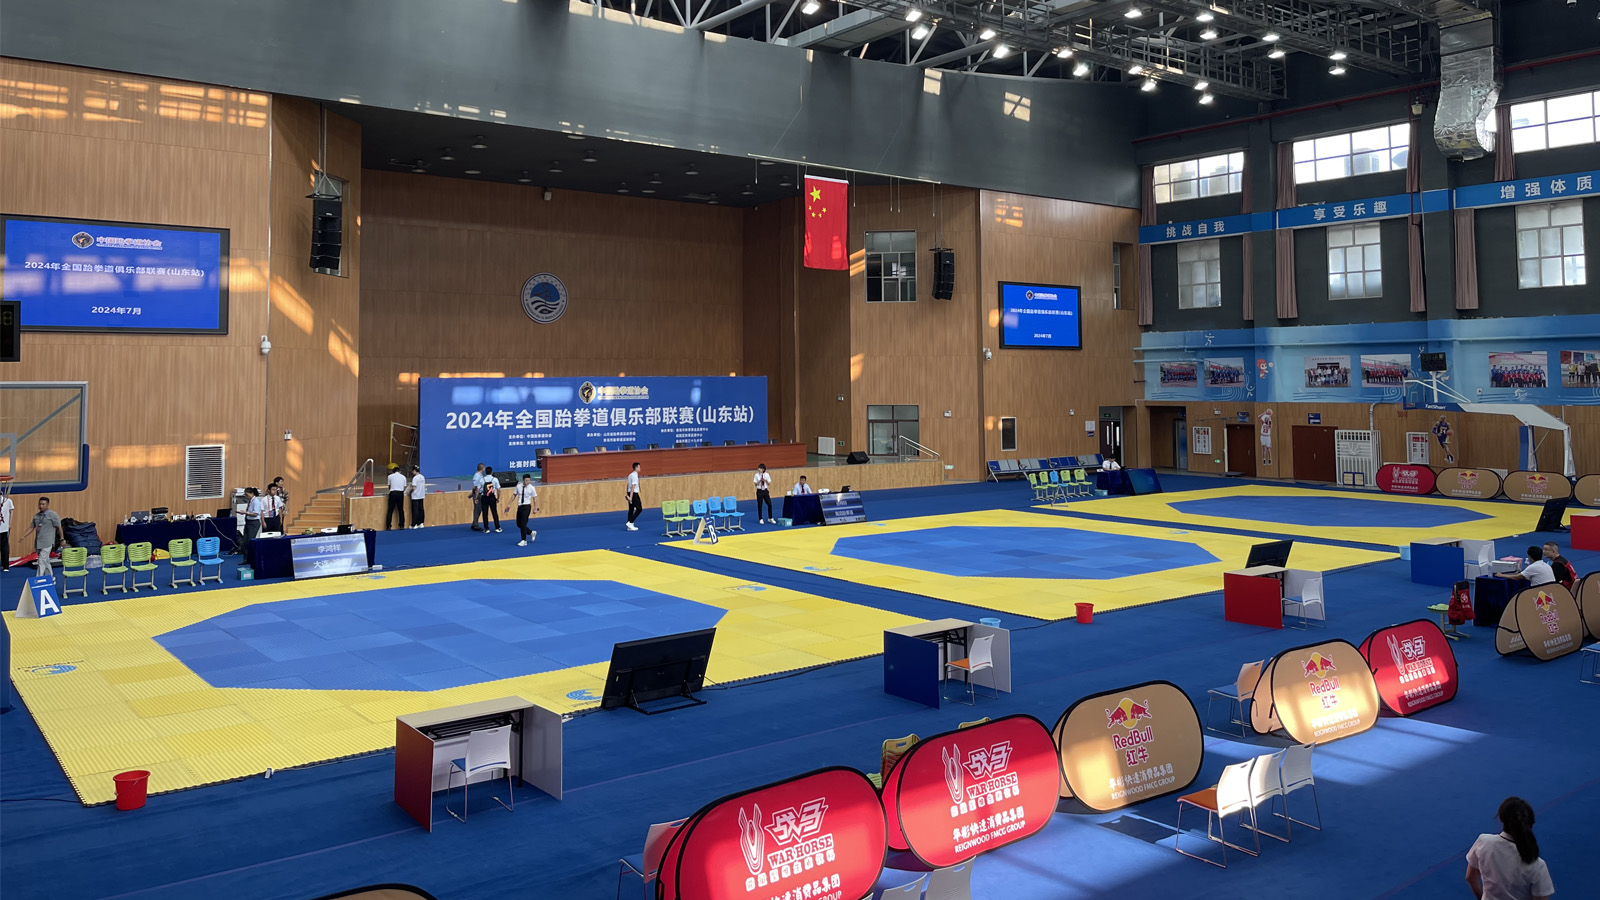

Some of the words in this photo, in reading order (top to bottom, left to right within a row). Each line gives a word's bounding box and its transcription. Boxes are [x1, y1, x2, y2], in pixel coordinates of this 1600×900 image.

[1499, 175, 1594, 201] 增强体质
[1312, 200, 1389, 221] 享受乐趣
[1165, 220, 1226, 238] 挑战自我
[24, 261, 206, 278] 2024年全国跆拳道俱乐部联赛(山东站)
[91, 305, 142, 316] 2024年7月
[445, 405, 754, 430] 2024年全国跆拳道俱乐部联赛(山东站)
[708, 524, 717, 543] B
[39, 589, 60, 616] A
[1309, 676, 1341, 697] RedBull
[1320, 693, 1338, 710] 红牛
[1112, 725, 1154, 751] RedBull
[965, 740, 1012, 779] 战马
[1125, 746, 1149, 767] 红牛
[967, 781, 988, 799] WAR
[987, 772, 1018, 794] HORSE
[1111, 785, 1143, 800] REIGNWOOD
[1143, 781, 1158, 791] FMCG
[1157, 776, 1176, 787] GROUP
[766, 798, 828, 844] 战马
[952, 805, 1025, 843] 华彬快速消费品集团
[954, 832, 991, 854] REIGNWOOD
[991, 826, 1007, 840] FMCG
[1006, 820, 1026, 836] GROUP
[768, 848, 795, 869] WAR
[795, 834, 834, 859] HORSE
